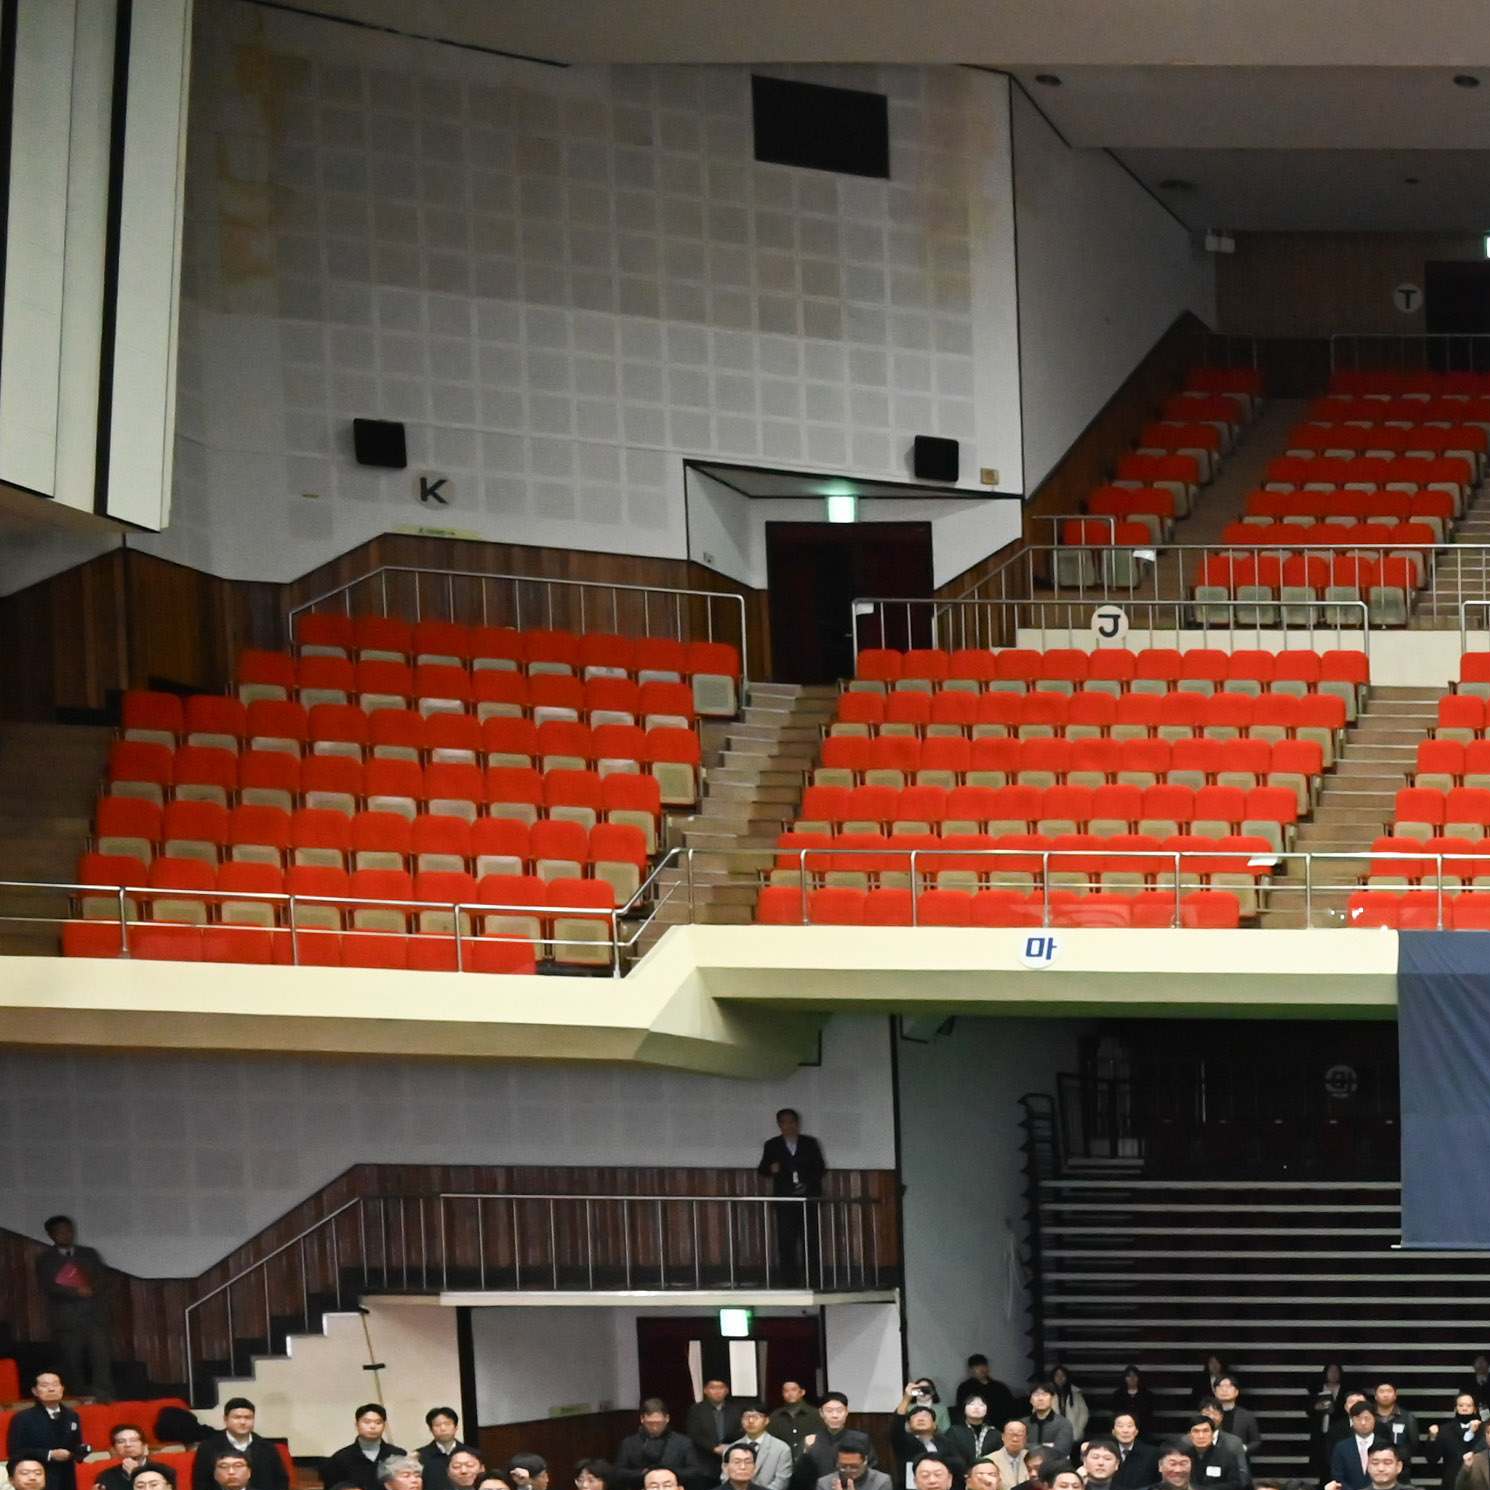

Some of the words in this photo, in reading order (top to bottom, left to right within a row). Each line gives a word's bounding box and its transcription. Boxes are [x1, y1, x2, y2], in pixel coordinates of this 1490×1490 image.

[1397, 289, 1417, 309] T
[420, 478, 447, 504] K
[1098, 614, 1121, 637] J
[1026, 937, 1057, 961] 마
